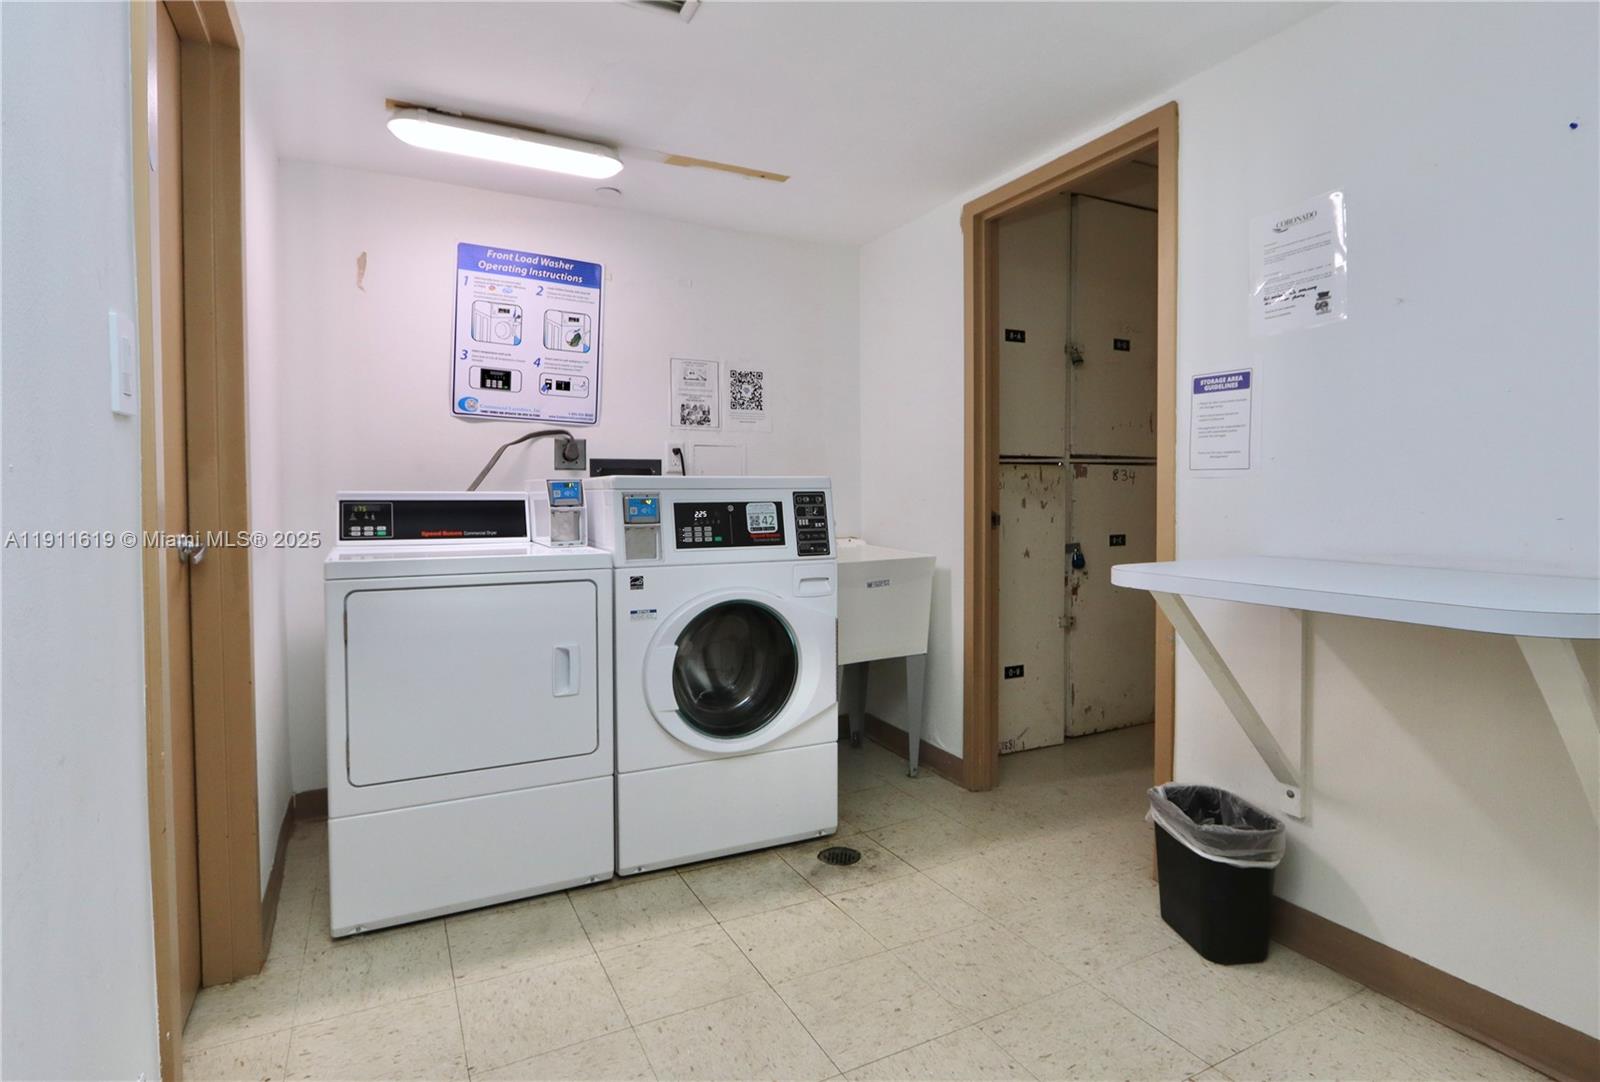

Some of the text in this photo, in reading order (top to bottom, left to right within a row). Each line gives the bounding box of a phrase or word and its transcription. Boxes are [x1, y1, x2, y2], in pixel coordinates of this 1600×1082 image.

[1275, 210, 1318, 229] CORONADO
[486, 249, 574, 271] Front Load Washer
[478, 260, 583, 284] Operating Instructions
[463, 276, 469, 286] 1
[536, 286, 544, 296] 2
[460, 349, 469, 360] 3
[533, 357, 541, 368] 4
[1200, 374, 1243, 386] STORAGE AREA
[1204, 382, 1239, 392] GUIDELINES
[1112, 468, 1136, 485] 834
[694, 510, 707, 518] 225
[761, 515, 775, 526] 42
